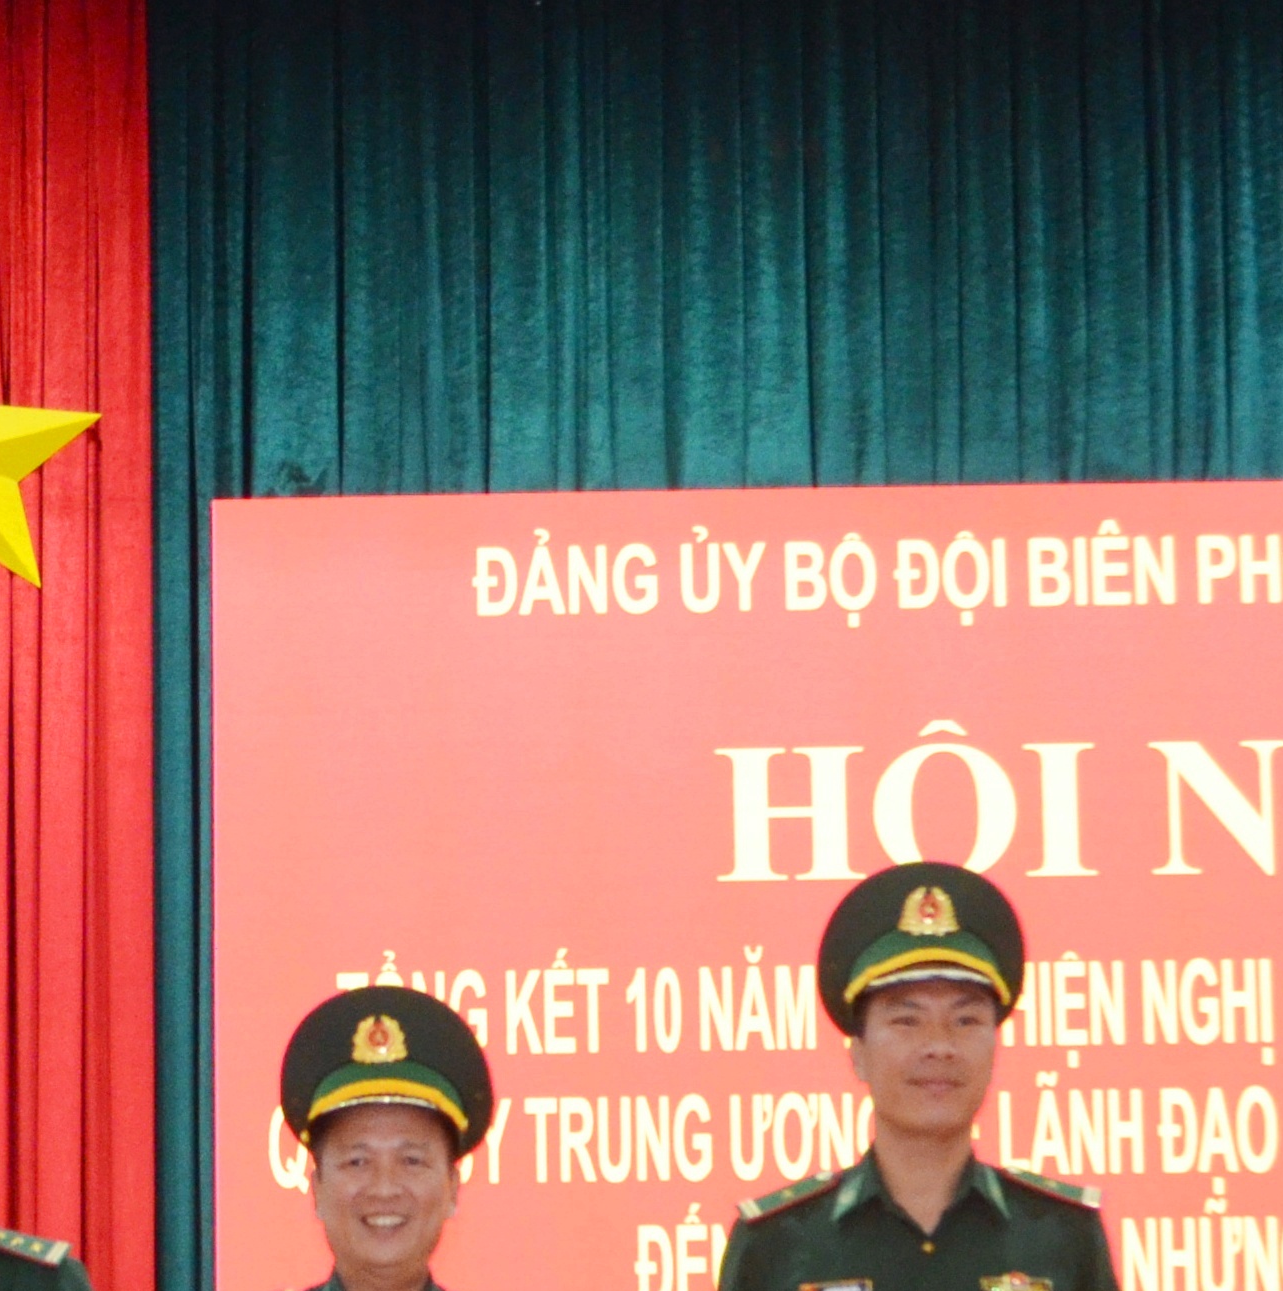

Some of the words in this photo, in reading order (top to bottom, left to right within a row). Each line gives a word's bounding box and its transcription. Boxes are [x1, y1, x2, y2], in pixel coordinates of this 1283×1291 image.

[471, 527, 659, 617] ĐẢNG
[679, 524, 767, 614] ỦY
[783, 531, 878, 628] BỘ
[892, 530, 1008, 627] ĐỘI
[1027, 518, 1177, 607] BIÊN
[505, 947, 610, 1055] KẾT
[625, 965, 683, 1054] 10
[697, 945, 817, 1052] NĂM
[1001, 950, 1126, 1069] HIỆN
[1141, 957, 1274, 1066] NGHỊ
[523, 1093, 714, 1184] TRUNG
[998, 1071, 1145, 1175] LÃNH
[1156, 1085, 1279, 1195] ĐẠO
